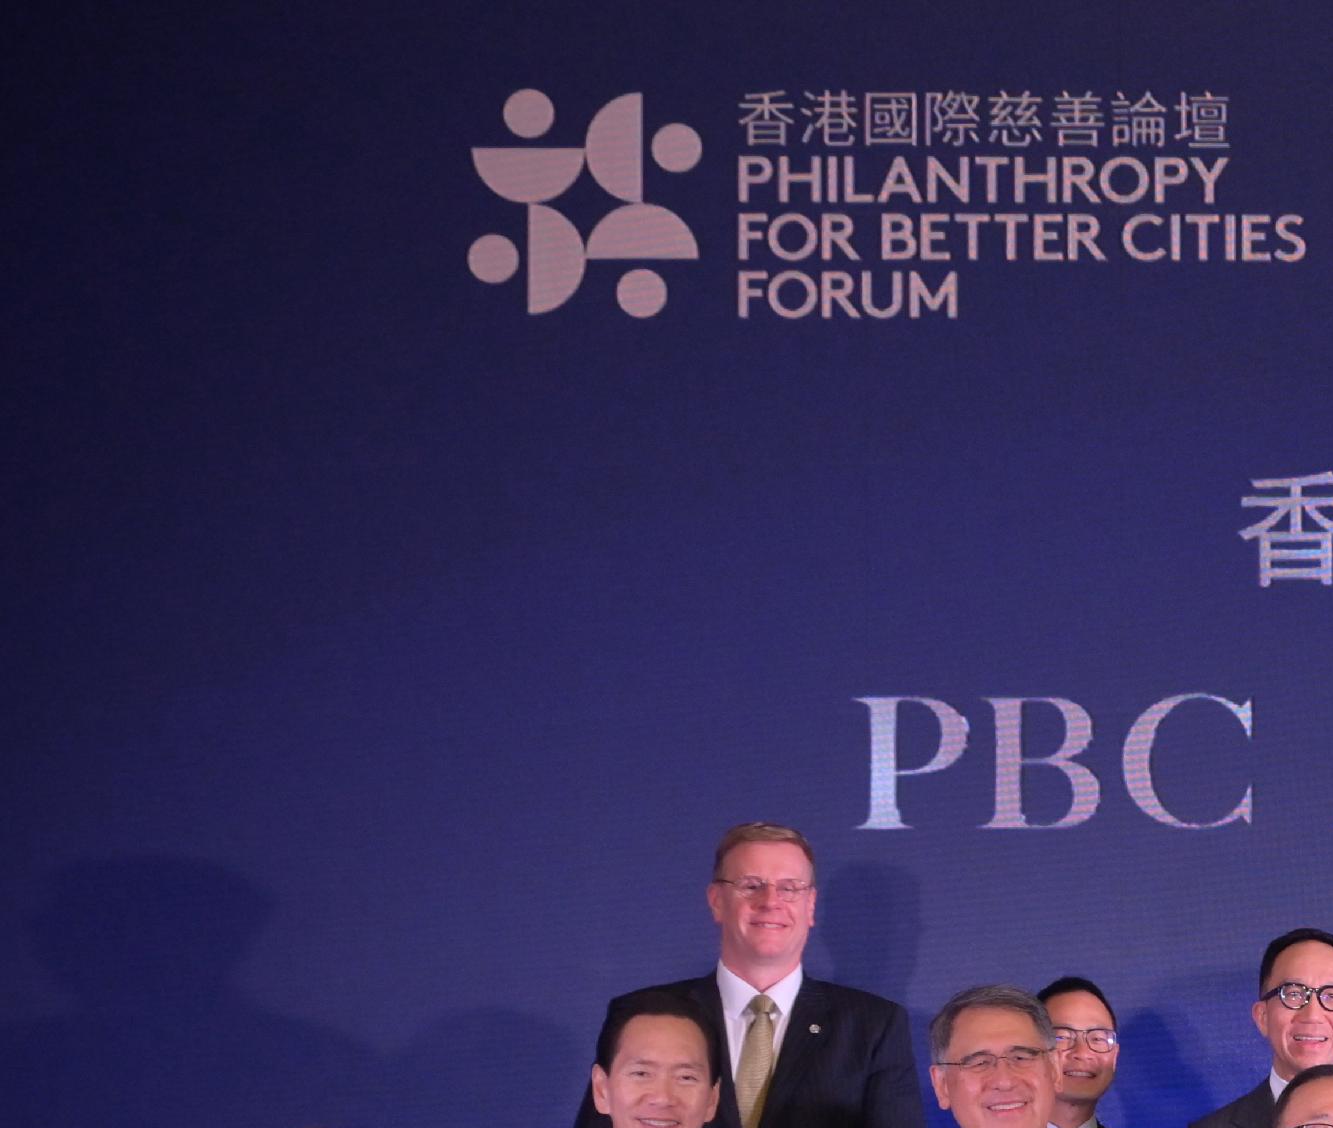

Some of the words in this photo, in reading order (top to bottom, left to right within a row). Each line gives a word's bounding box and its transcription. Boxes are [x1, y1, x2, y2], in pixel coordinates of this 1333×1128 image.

[738, 89, 1231, 149] 香港國際慈善論壇
[738, 155, 1229, 205] PHILANTHROPY
[738, 213, 861, 262] FOR
[881, 213, 1107, 262] BETTER
[1122, 213, 1307, 263] CITIES
[738, 270, 958, 320] FORUM
[854, 692, 1254, 830] PBC
